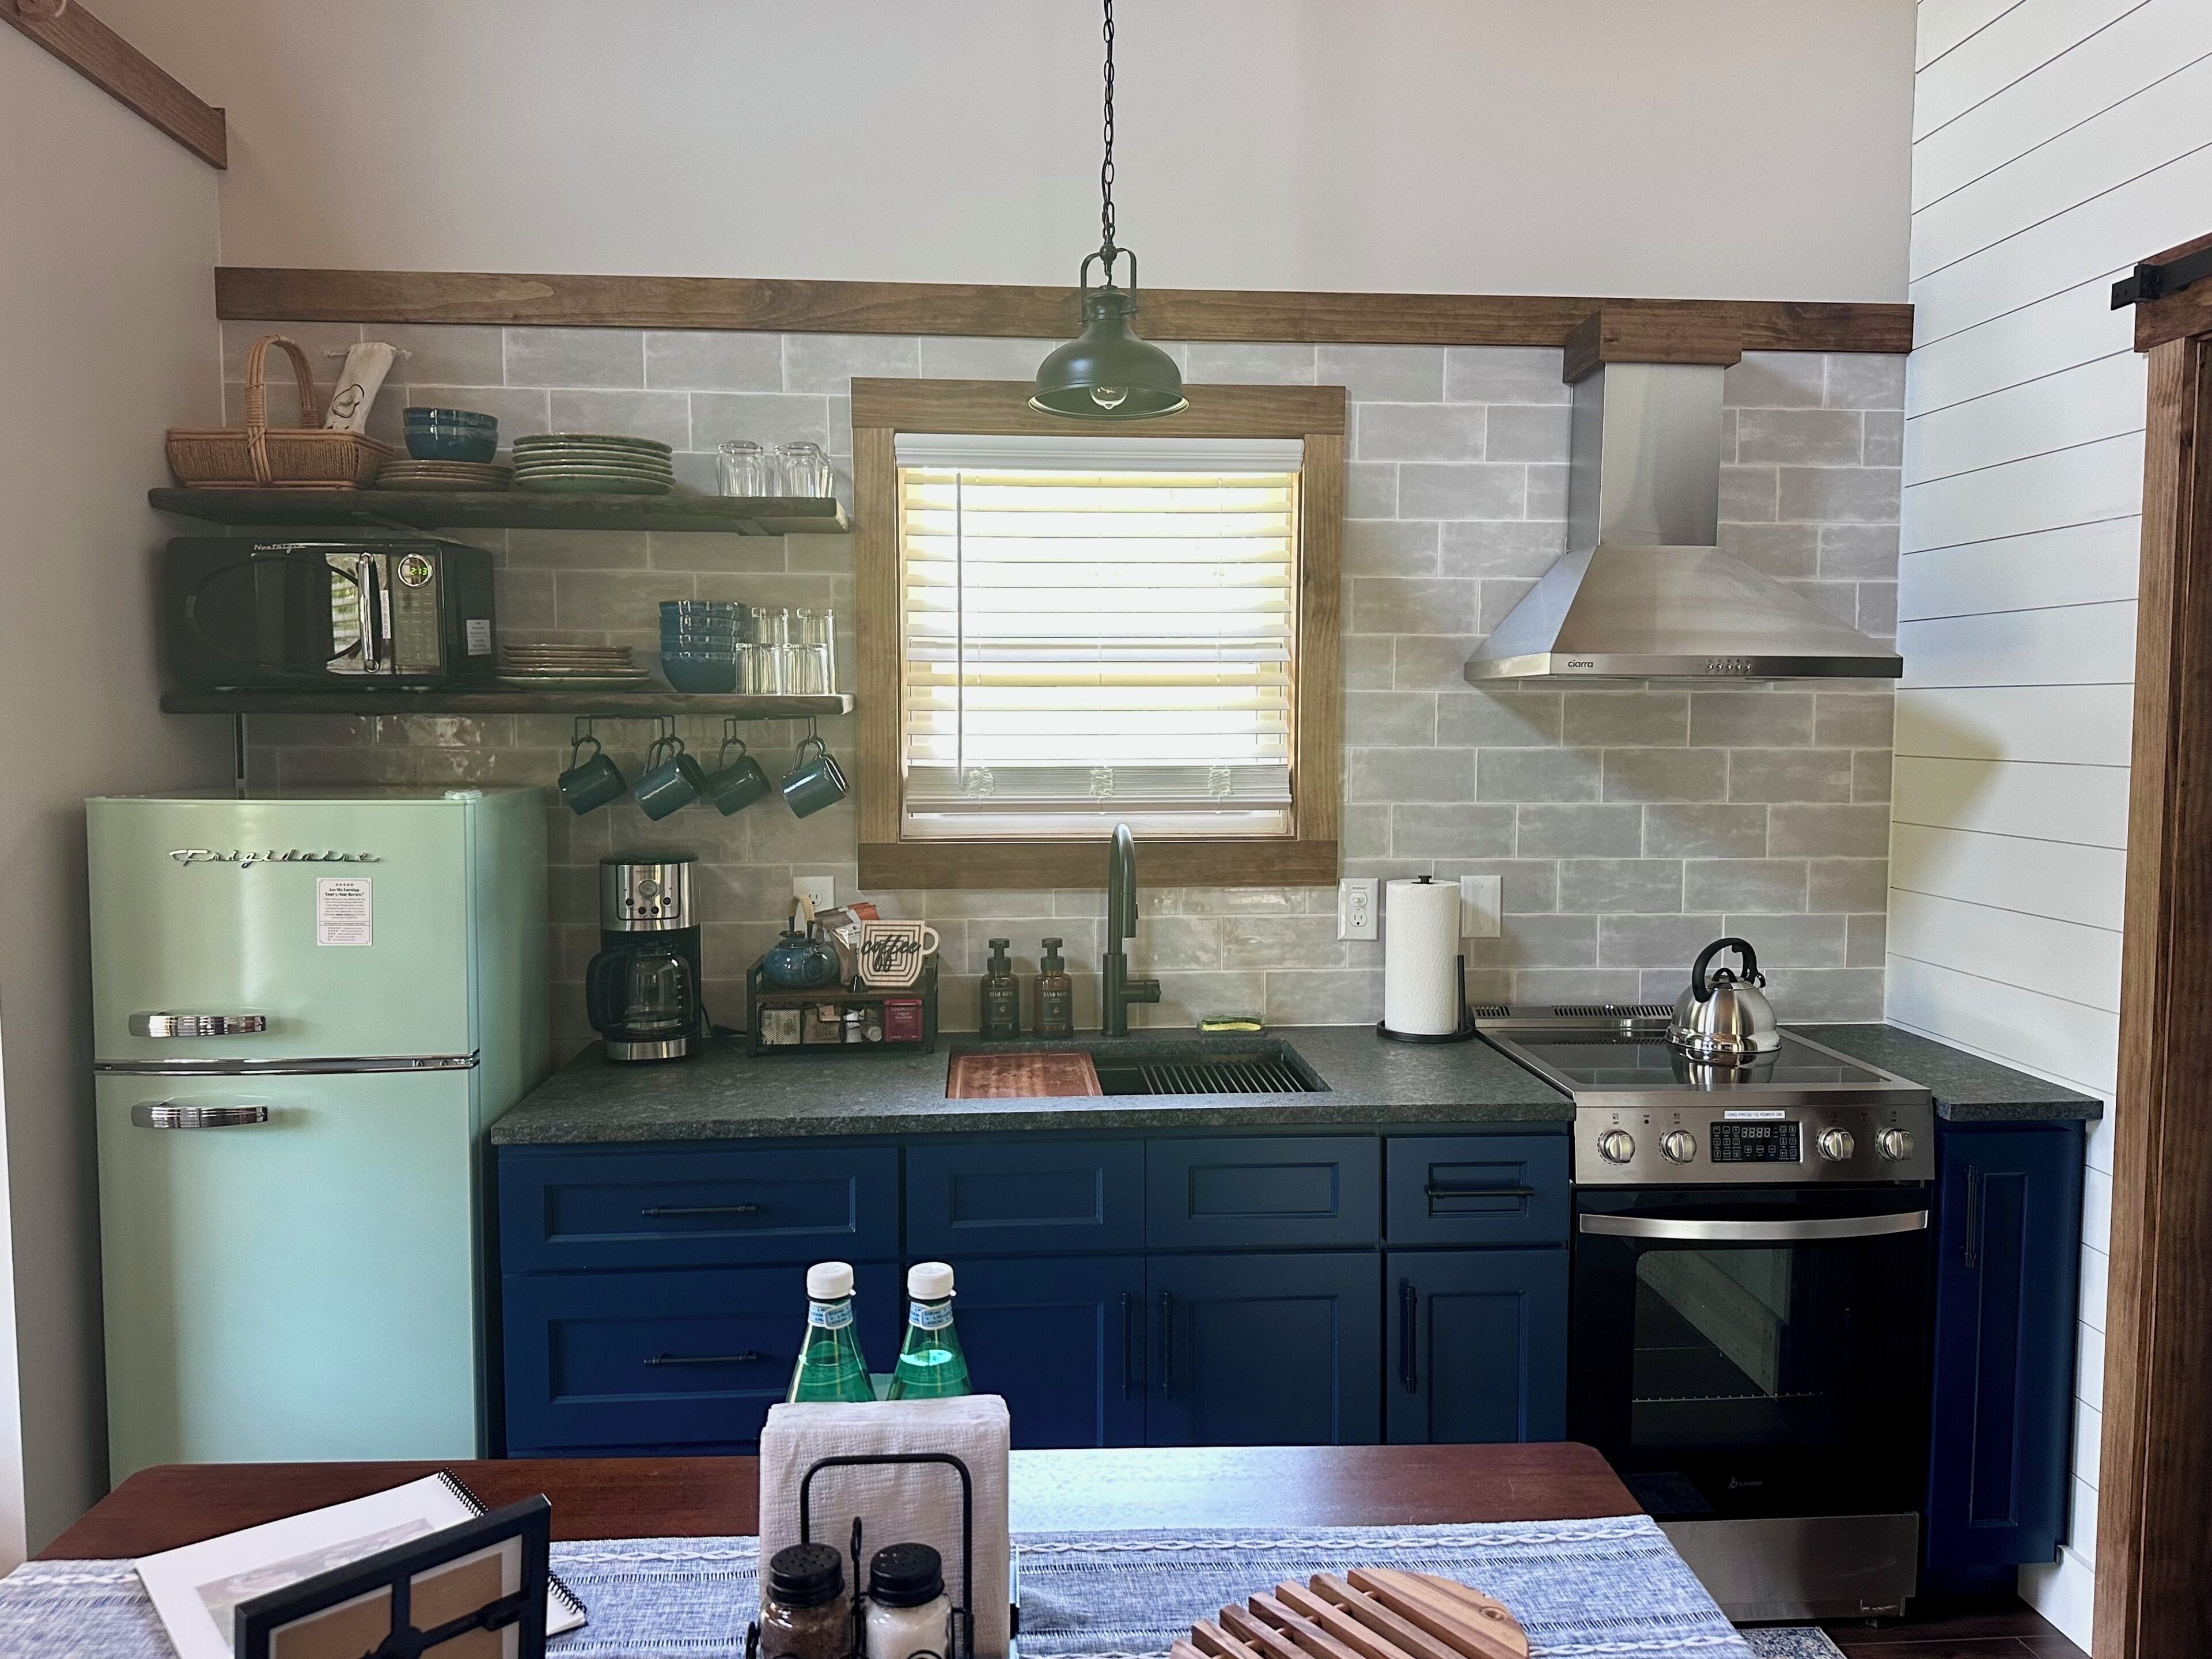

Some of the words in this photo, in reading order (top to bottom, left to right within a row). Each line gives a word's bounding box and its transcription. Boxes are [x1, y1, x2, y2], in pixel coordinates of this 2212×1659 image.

[410, 567, 428, 575] 2:13
[1567, 659, 1593, 668] ciarra
[169, 849, 381, 869] Frigidaire
[861, 934, 921, 972] coffee
